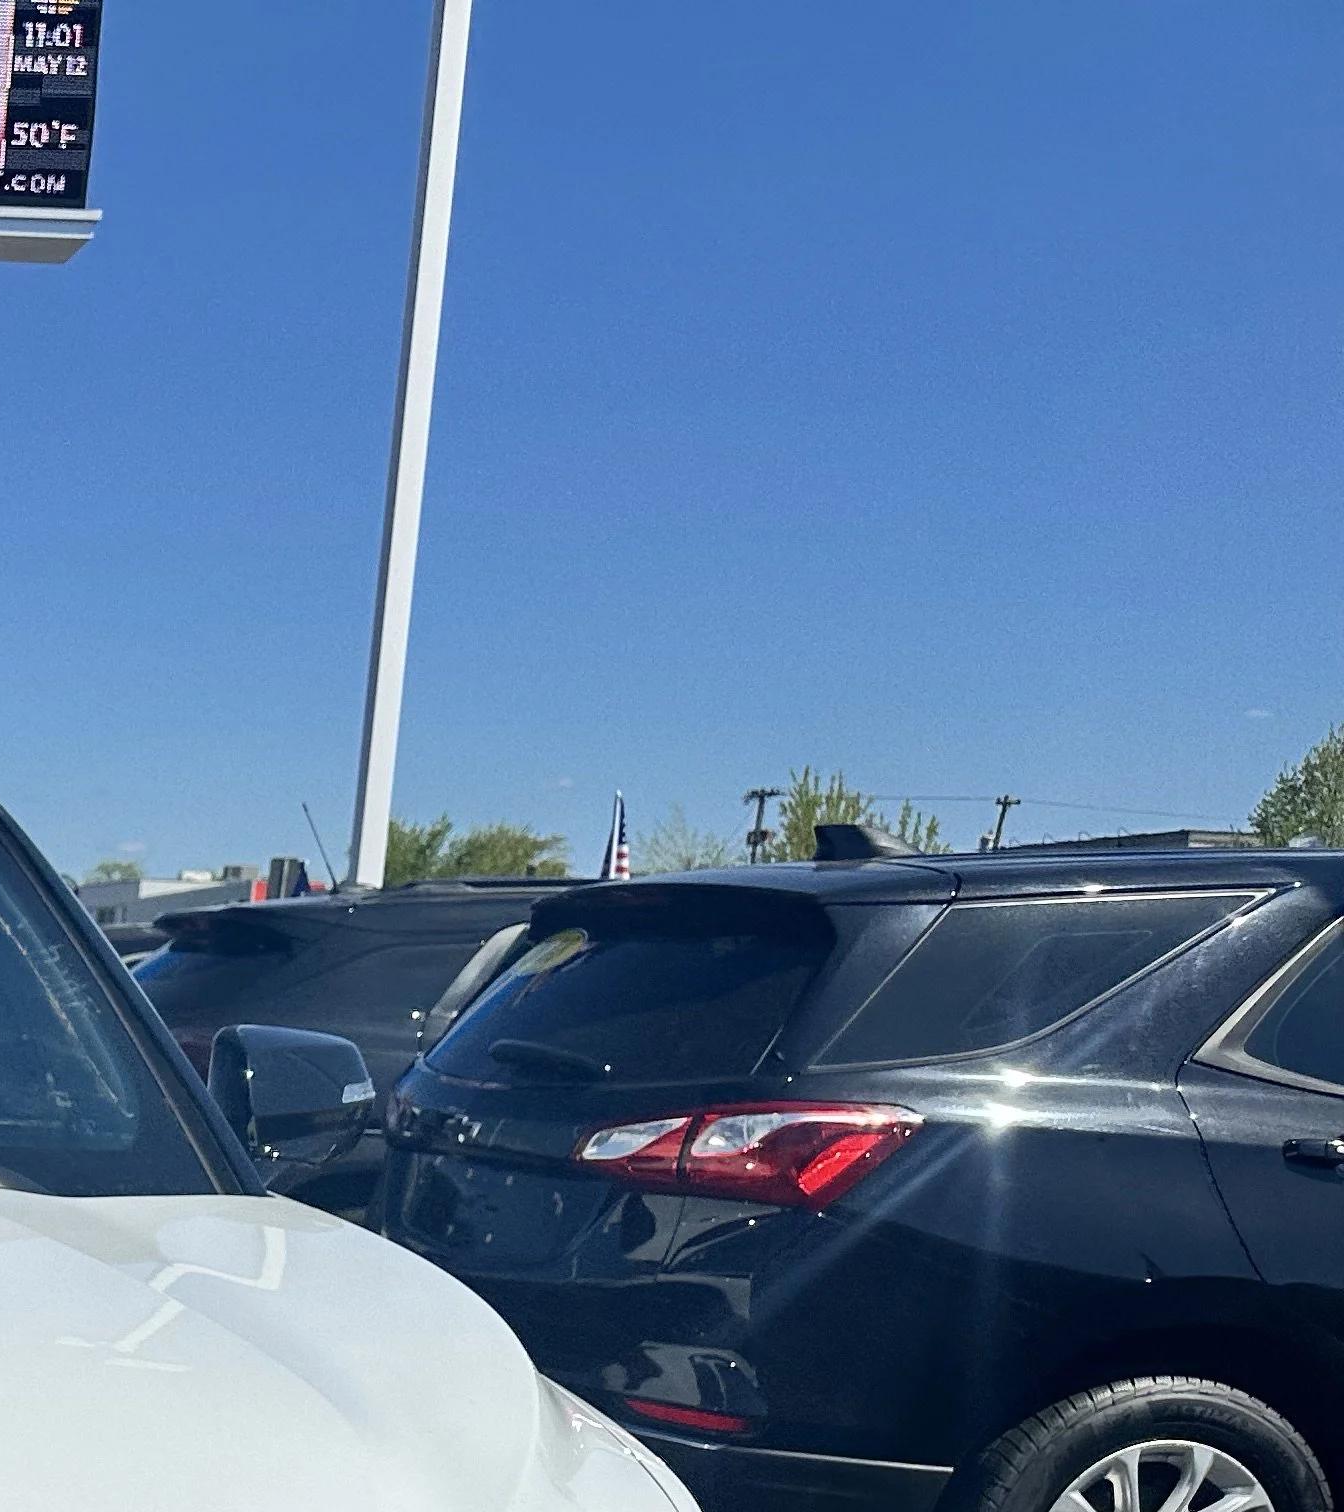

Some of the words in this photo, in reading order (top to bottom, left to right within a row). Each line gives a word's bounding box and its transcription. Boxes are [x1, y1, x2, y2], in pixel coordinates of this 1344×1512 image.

[23, 21, 84, 48] 11:01
[13, 54, 62, 75] MAY
[65, 55, 88, 76] 12
[11, 120, 78, 149] 50°F
